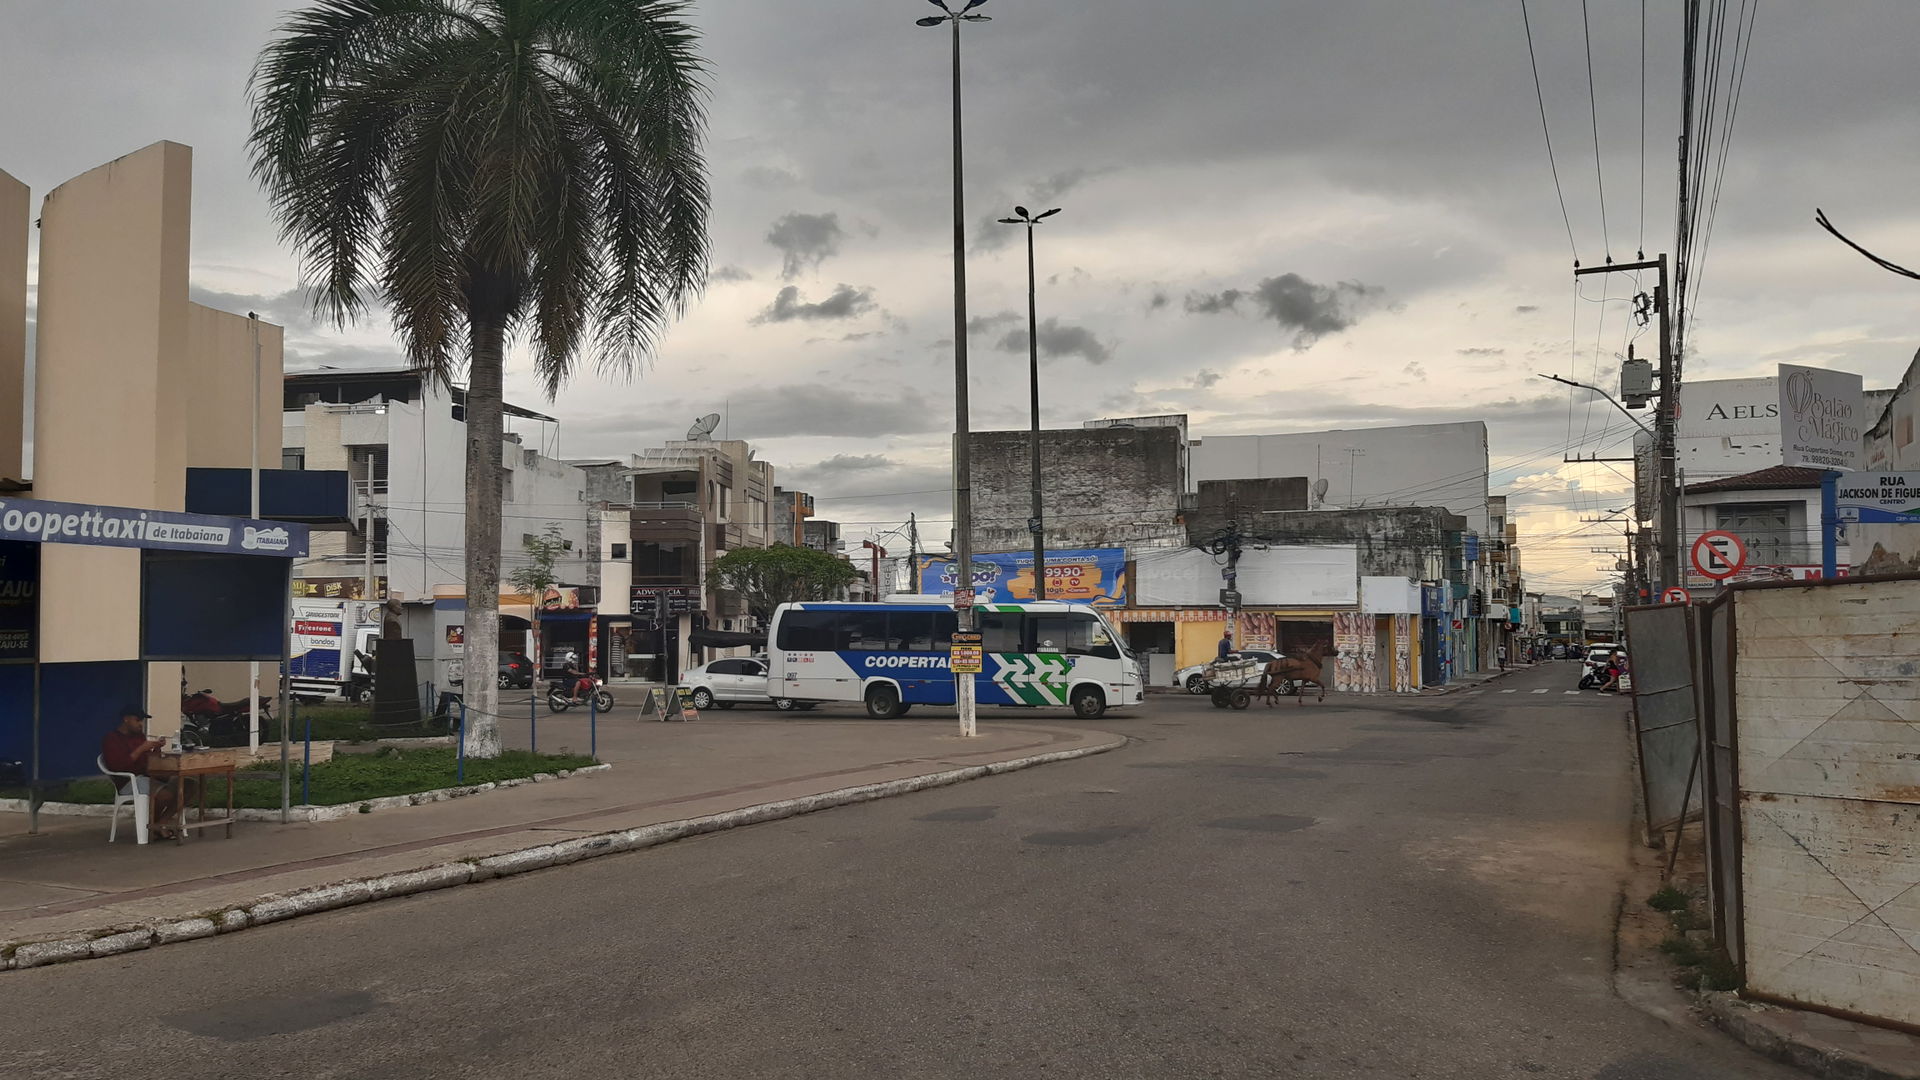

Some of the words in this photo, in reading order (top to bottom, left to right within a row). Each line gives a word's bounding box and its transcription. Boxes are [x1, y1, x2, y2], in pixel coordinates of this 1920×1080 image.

[1811, 393, 1852, 420] Balão
[1879, 476, 1905, 486] RUA
[1838, 488, 1879, 499] JACKSON
[1881, 488, 1893, 499] DE
[153, 526, 166, 538] de
[170, 528, 224, 542] Itabaiana
[256, 537, 288, 546] ITABAIANA
[1045, 567, 1081, 578] 99,90
[326, 582, 343, 593] DISK
[310, 637, 336, 647] bandag
